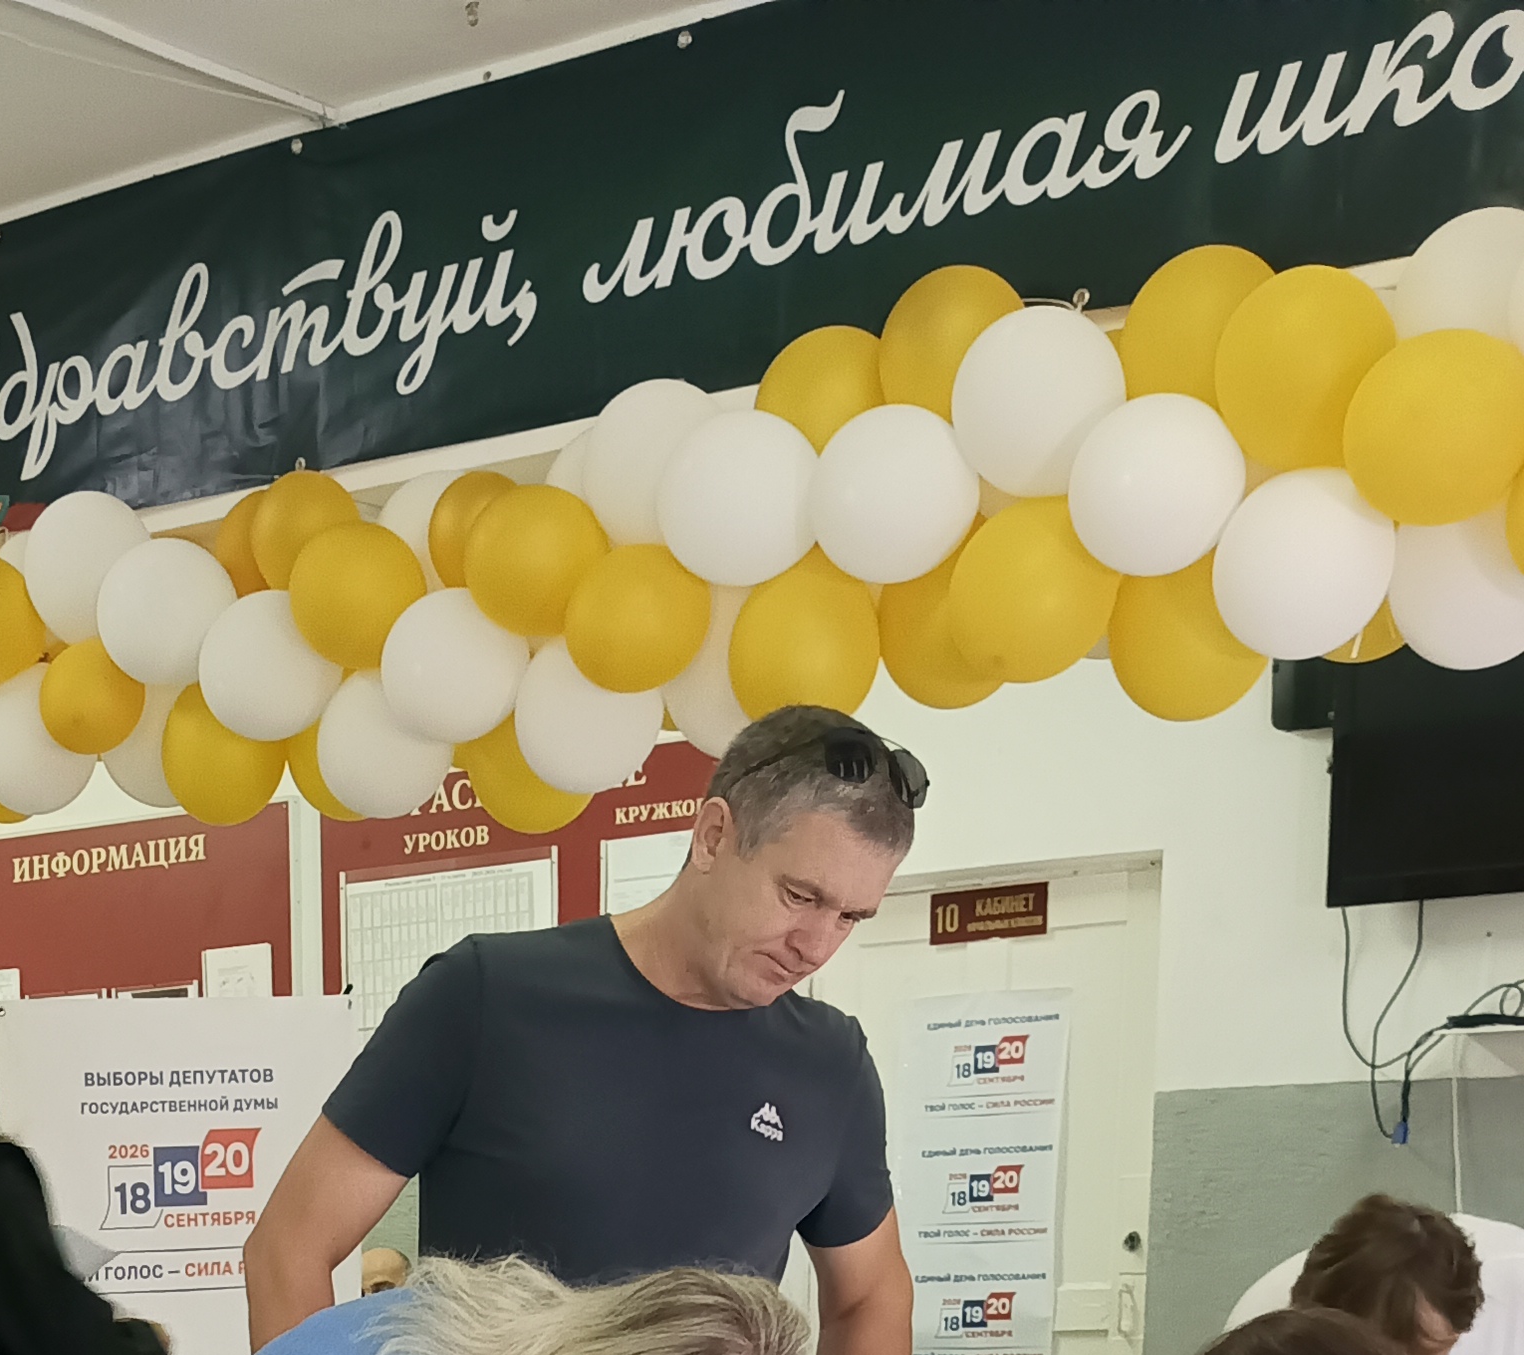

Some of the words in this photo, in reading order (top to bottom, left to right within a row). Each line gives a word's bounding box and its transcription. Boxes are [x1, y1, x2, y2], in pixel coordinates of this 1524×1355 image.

[582, 88, 1193, 305] любимая
[1213, 9, 1524, 164] шко
[403, 825, 490, 854] УРОКОВ
[12, 833, 206, 883] ИНФОРМАЦИЯ
[935, 903, 959, 934] 10
[975, 893, 1035, 917] КАБИНЕТ
[955, 1062, 972, 1079] 18
[976, 1051, 995, 1069] 19
[998, 1041, 1024, 1060] 20
[84, 1071, 164, 1087] ВЫБОРЫ
[169, 1068, 274, 1088] ДЕПУТАТОВ
[80, 1096, 229, 1115] ГОСУДАРСТВЕННОЙ
[233, 1097, 279, 1113] ДУМЫ
[108, 1144, 150, 1159] 2026
[114, 1182, 152, 1215] 18
[158, 1160, 196, 1195] 19
[203, 1142, 250, 1177] 20
[950, 1191, 967, 1206] 18
[971, 1180, 990, 1197] 19
[993, 1170, 1018, 1189] 20
[163, 1211, 256, 1228] СЕНТЯБРЯ
[104, 1264, 163, 1281] ГОЛОС
[185, 1261, 234, 1278] СИЛА
[943, 1316, 960, 1331] 18
[964, 1306, 983, 1323] 19
[986, 1297, 1010, 1315] 20
